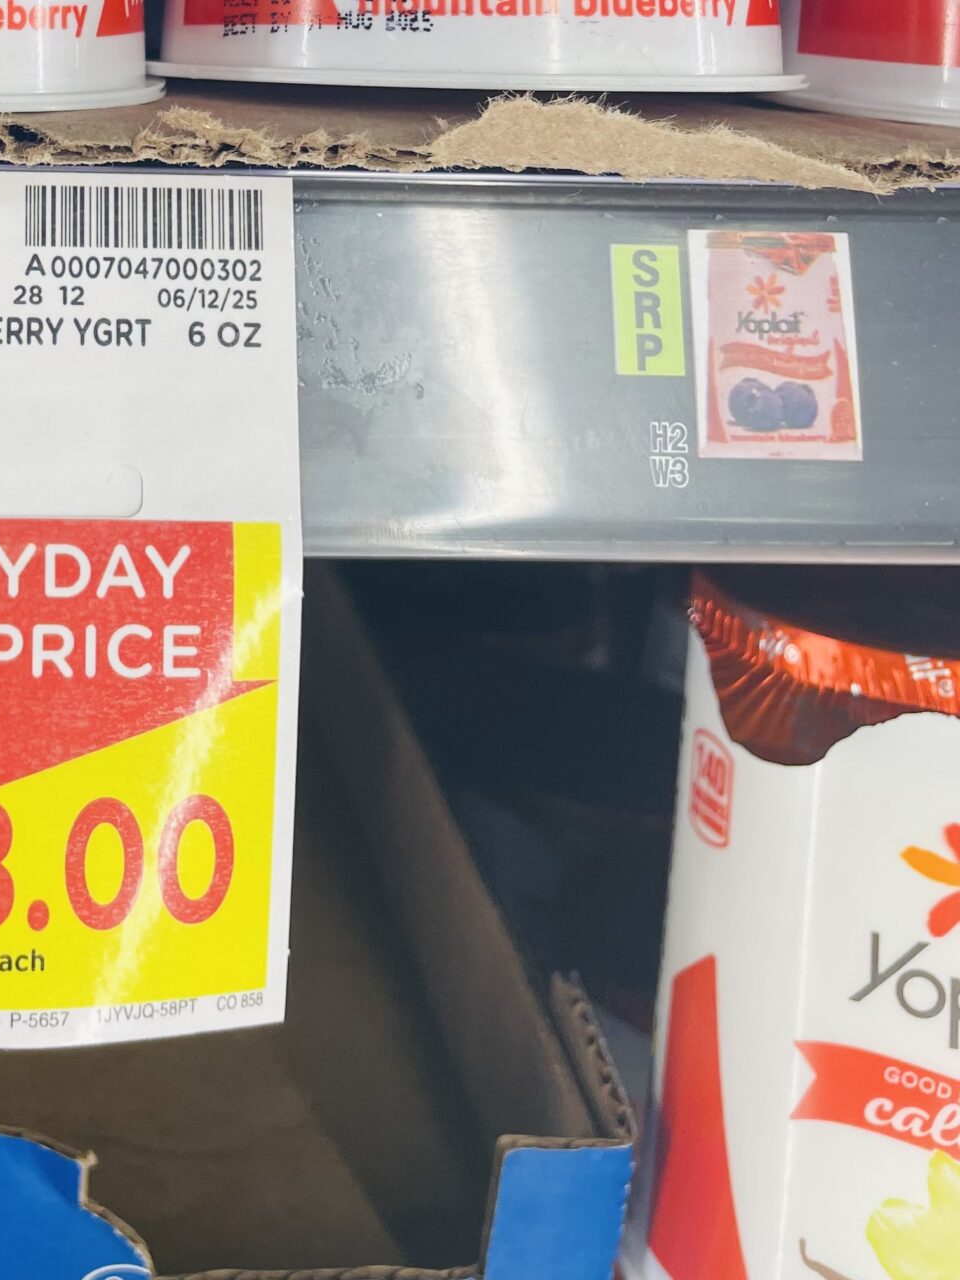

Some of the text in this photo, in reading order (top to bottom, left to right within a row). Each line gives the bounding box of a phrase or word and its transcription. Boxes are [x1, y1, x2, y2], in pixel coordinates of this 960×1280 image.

[336, 9, 374, 31] AUG
[24, 253, 263, 283] A0007047000302
[12, 284, 259, 313] 28 12 06/12/25
[631, 248, 664, 372] SRP
[73, 317, 153, 348] YGRT
[187, 321, 206, 347] 6
[216, 321, 263, 349] OZ
[735, 310, 806, 340] Yoplait
[649, 421, 689, 453] H2
[648, 455, 690, 488] W3
[10, 1011, 70, 1029] P-5657
[97, 998, 198, 1025] 1JYVJQ-58PT
[216, 995, 238, 1012] CO
[240, 991, 264, 1009] 858
[883, 1065, 953, 1100] GOOD
